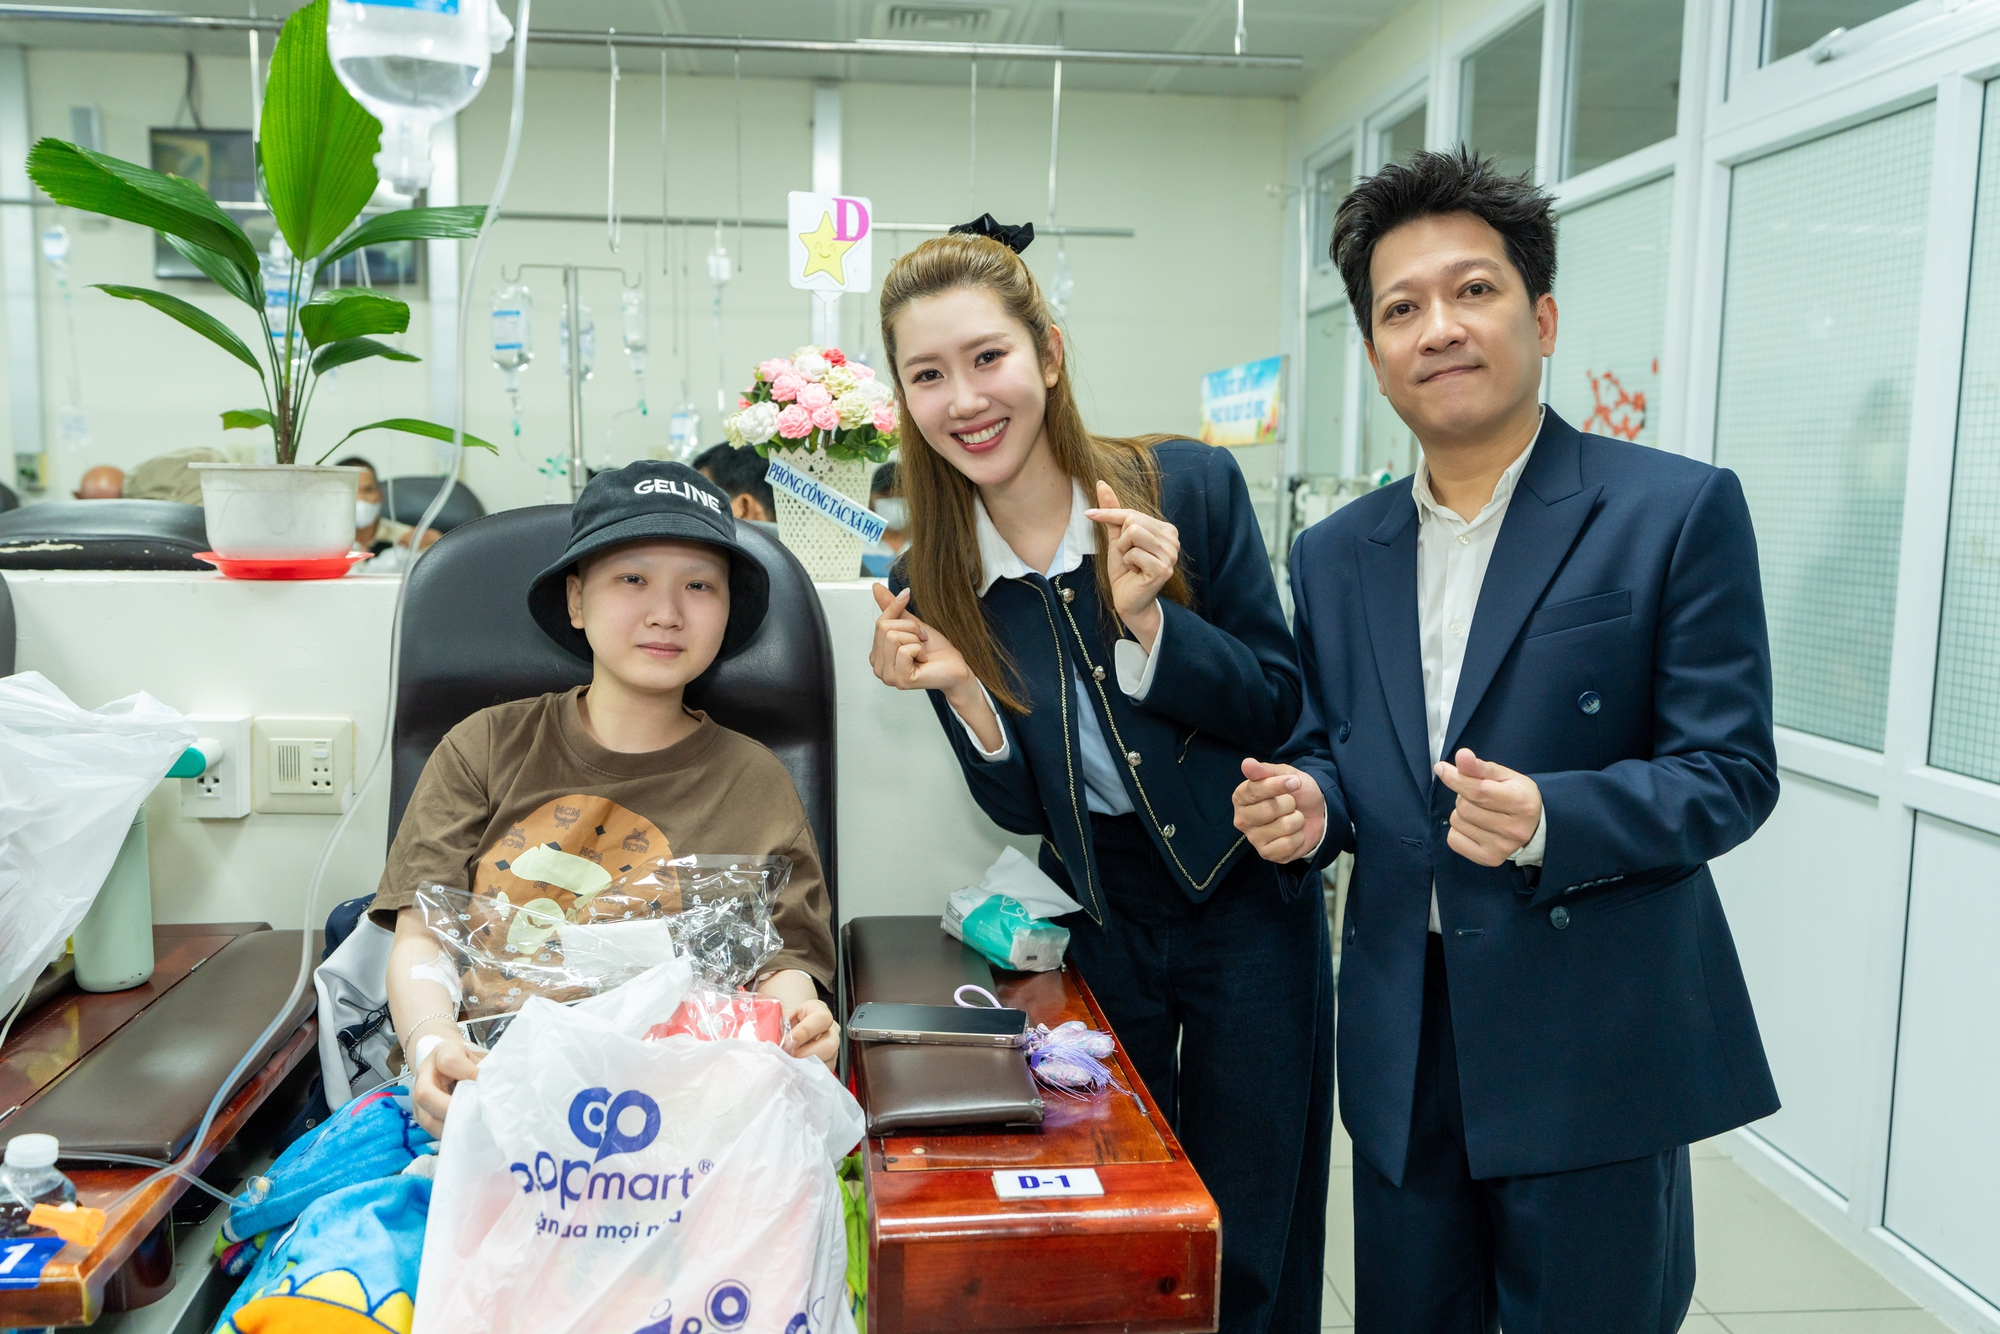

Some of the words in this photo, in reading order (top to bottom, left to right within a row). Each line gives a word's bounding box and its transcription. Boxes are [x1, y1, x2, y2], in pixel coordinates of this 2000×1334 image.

[831, 198, 869, 242] D
[633, 478, 722, 515] GELINE
[801, 482, 831, 510] CÔNG
[828, 498, 852, 522] TÁC
[846, 510, 865, 531] XÃ
[861, 518, 883, 542] HỘI
[1018, 1175, 1071, 1189] D-1
[596, 1221, 639, 1243] mọi
